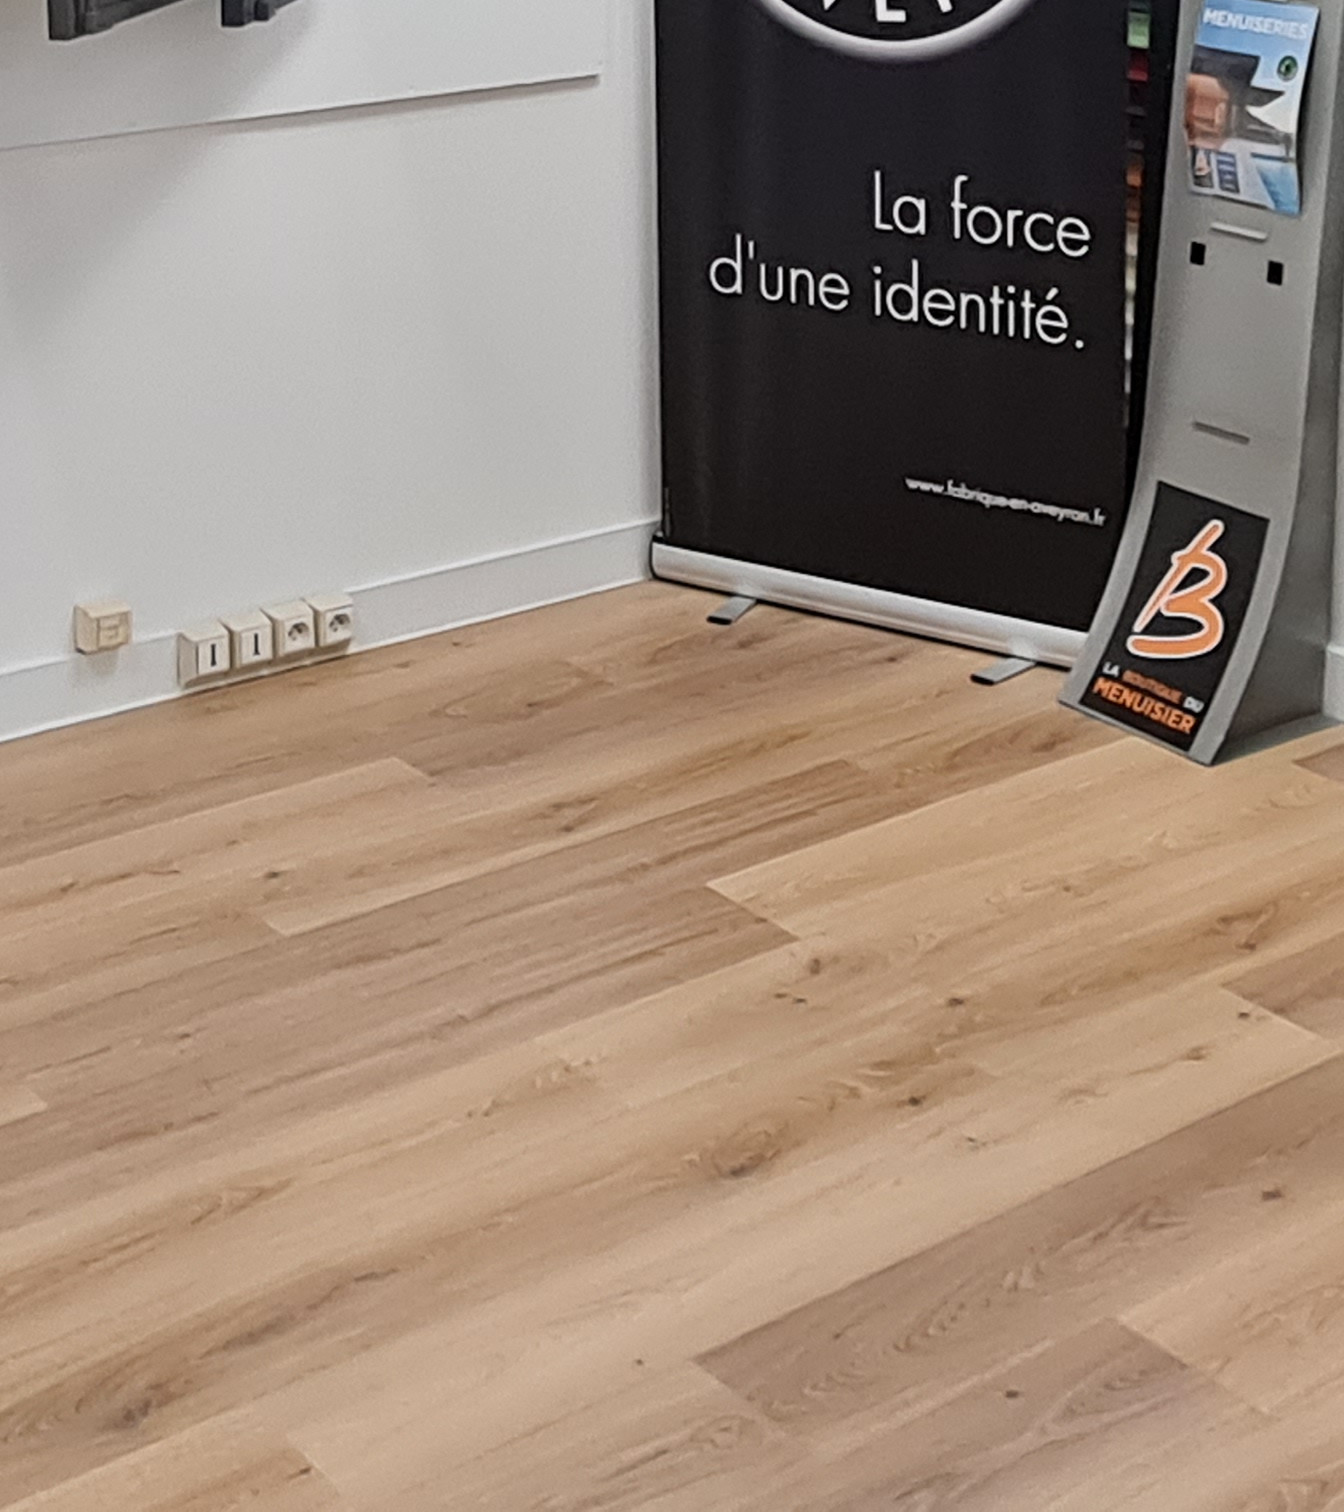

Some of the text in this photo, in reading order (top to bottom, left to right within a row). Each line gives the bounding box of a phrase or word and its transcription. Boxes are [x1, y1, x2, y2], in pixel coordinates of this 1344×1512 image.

[1203, 7, 1309, 39] MENUISERIES
[873, 170, 1091, 257] La force
[709, 233, 1085, 349] d'une identité.
[1092, 676, 1196, 735] MENUISIER
[1102, 661, 1205, 713] LA DU
